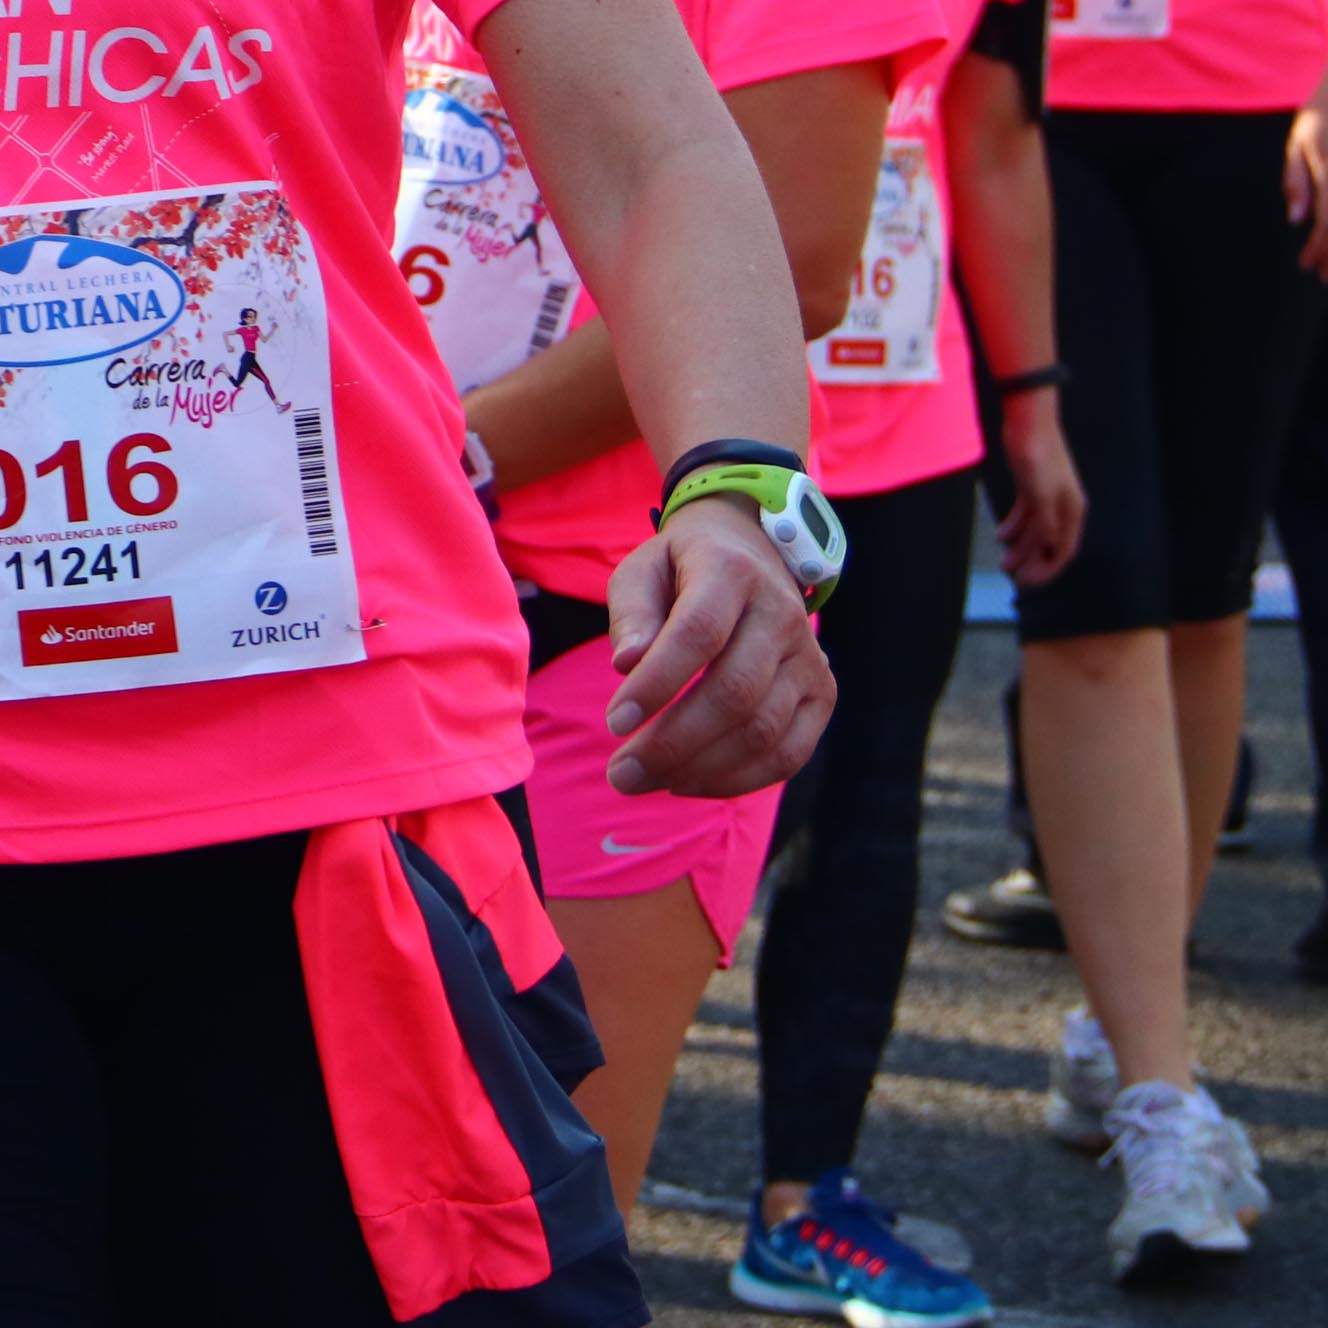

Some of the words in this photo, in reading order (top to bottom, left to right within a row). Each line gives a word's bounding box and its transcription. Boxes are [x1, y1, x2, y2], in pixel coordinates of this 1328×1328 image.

[66, 270, 156, 290] LECHERA
[399, 244, 451, 307] 6
[104, 357, 207, 390] Carrera
[132, 388, 151, 410] de
[155, 386, 170, 408] la
[169, 377, 244, 429] Mujer
[35, 527, 104, 544] VIOLENCIA
[106, 525, 125, 537] DE
[126, 519, 178, 534] GÉNERO
[4, 539, 141, 591] 11241
[64, 620, 156, 644] Santander
[231, 620, 321, 648] ZURICH
